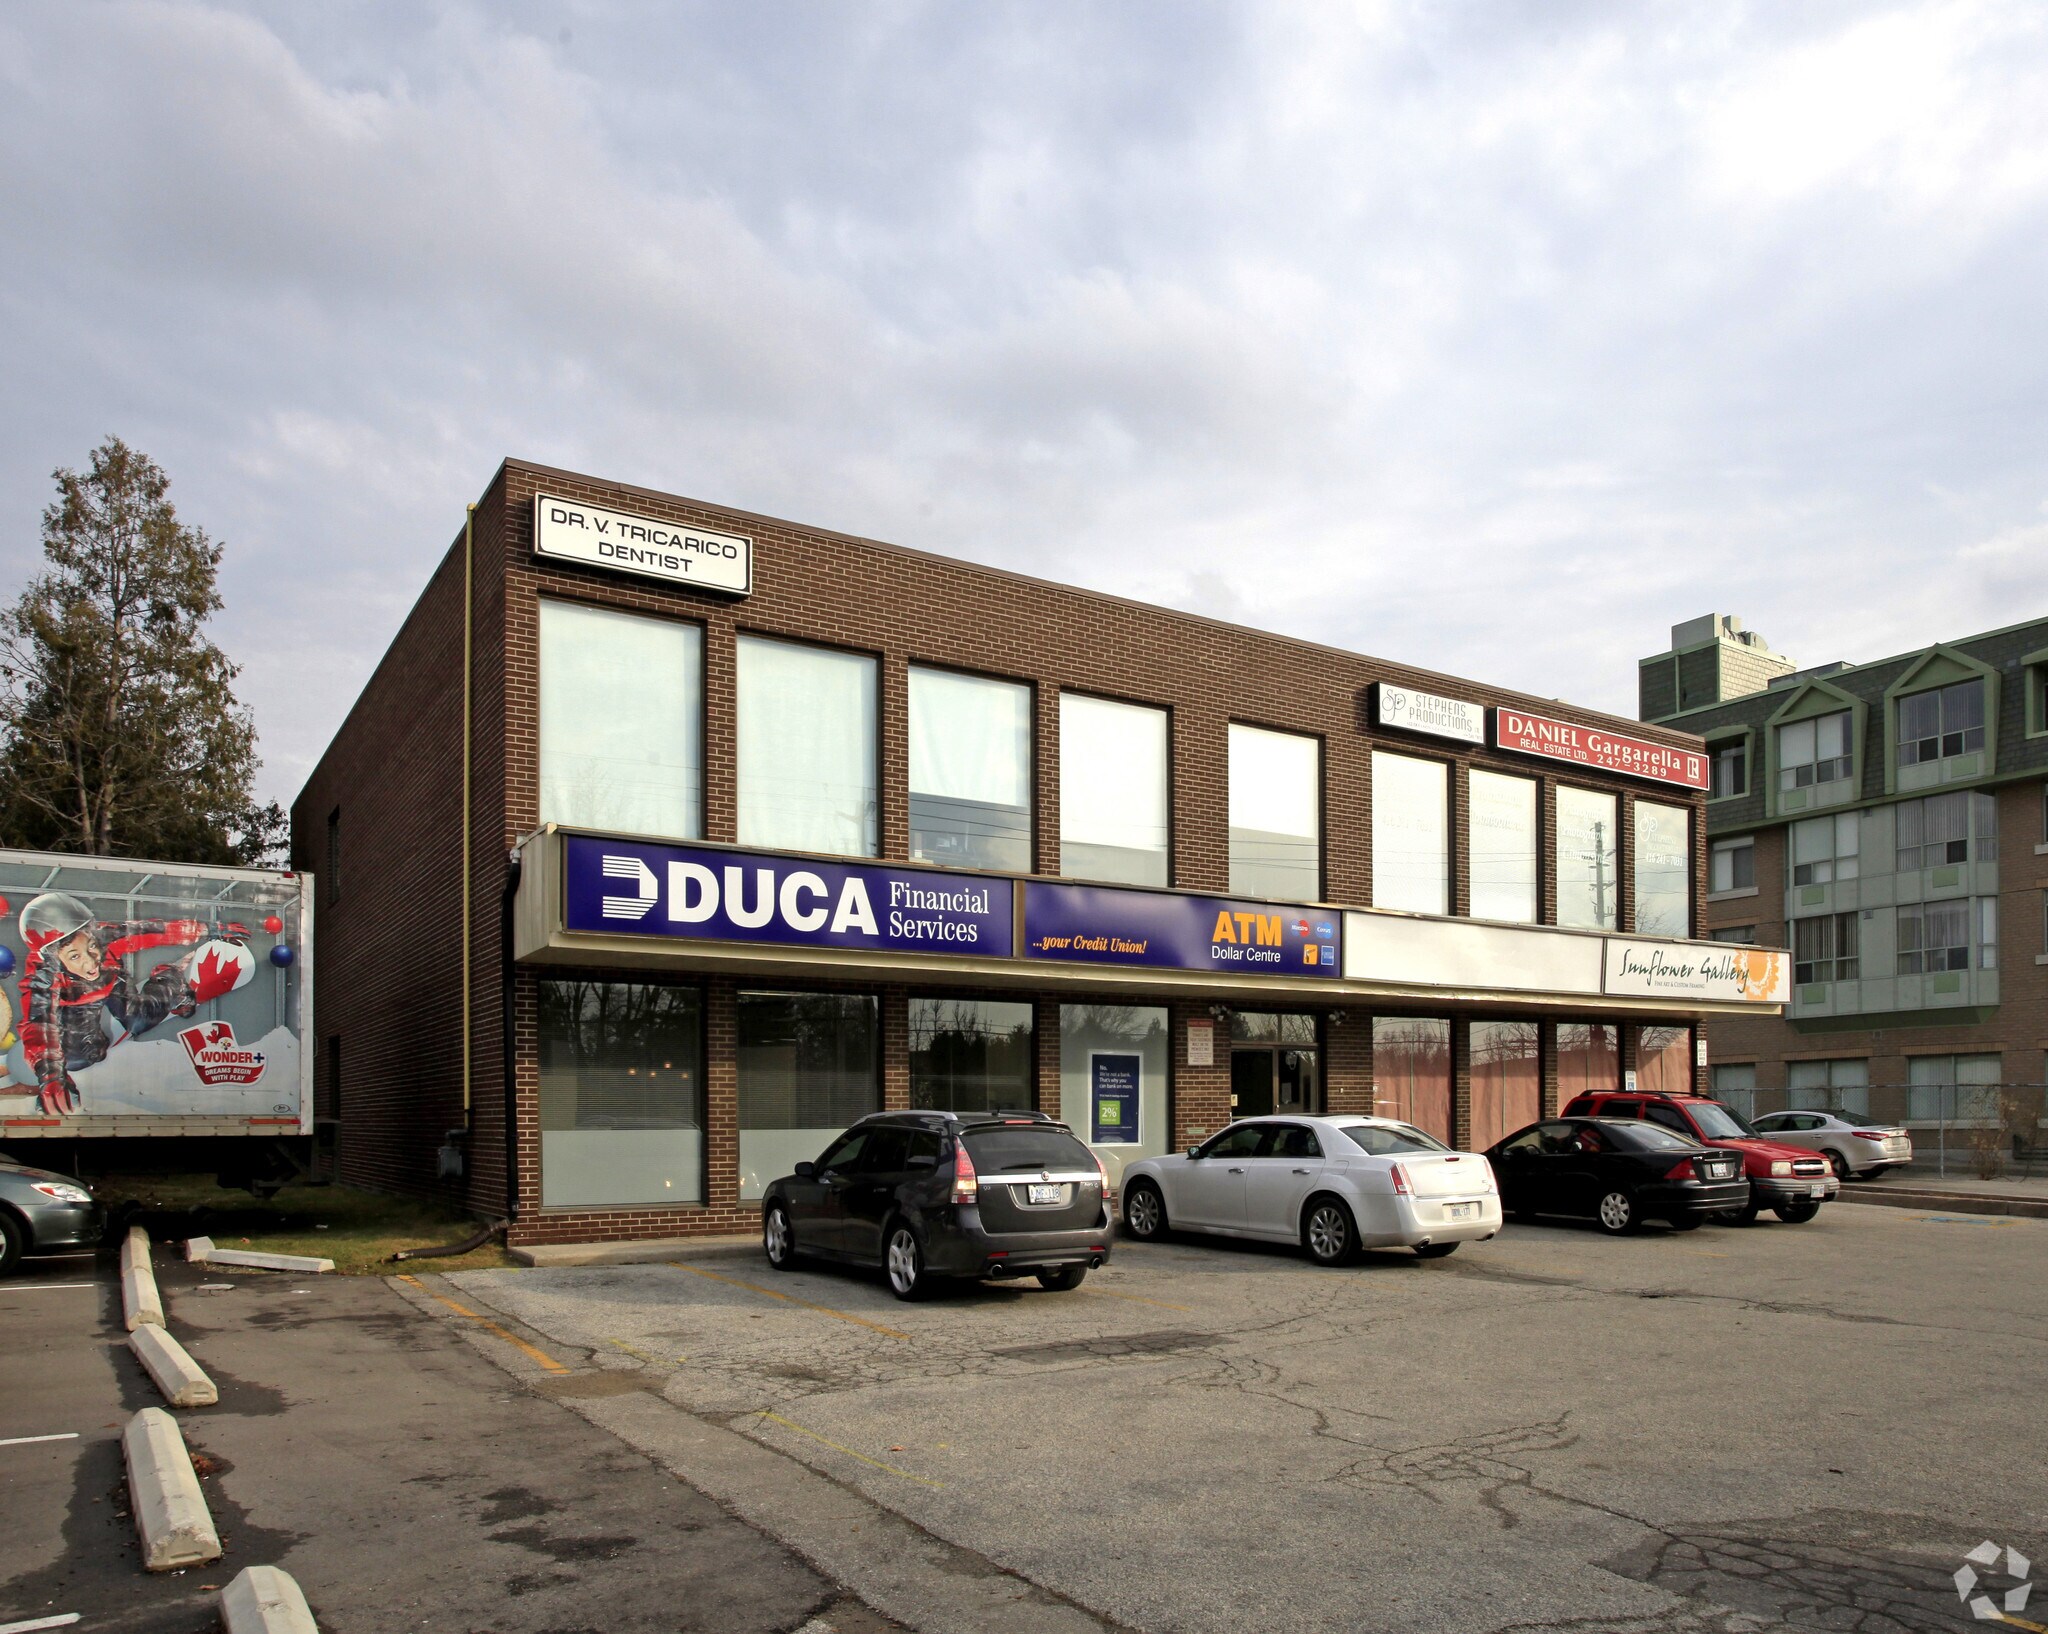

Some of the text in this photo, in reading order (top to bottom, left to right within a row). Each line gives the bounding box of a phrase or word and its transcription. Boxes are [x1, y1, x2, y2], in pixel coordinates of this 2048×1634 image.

[551, 508, 738, 559] DR. V. TRICARICO
[598, 541, 693, 572] DENTIST
[1409, 706, 1473, 732] PRODUCTIONS
[1415, 694, 1467, 717] STEPHENS
[1507, 715, 1581, 748] DANIEL
[1587, 734, 1682, 770] Gargarella
[1520, 737, 1668, 777] REAL ESTATE LTD. 247-3289
[667, 860, 880, 936] DUCA
[888, 880, 990, 915] Financial
[888, 911, 979, 943] Services
[1211, 911, 1283, 947] ATM
[1072, 935, 1108, 952] Credit
[1110, 938, 1148, 955] Union!
[1211, 945, 1282, 964] Dollar Centre
[1619, 948, 1750, 994] Sunflower Gallery
[204, 1067, 252, 1076] DREAMS BEGIN
[211, 1074, 228, 1082] WITH
